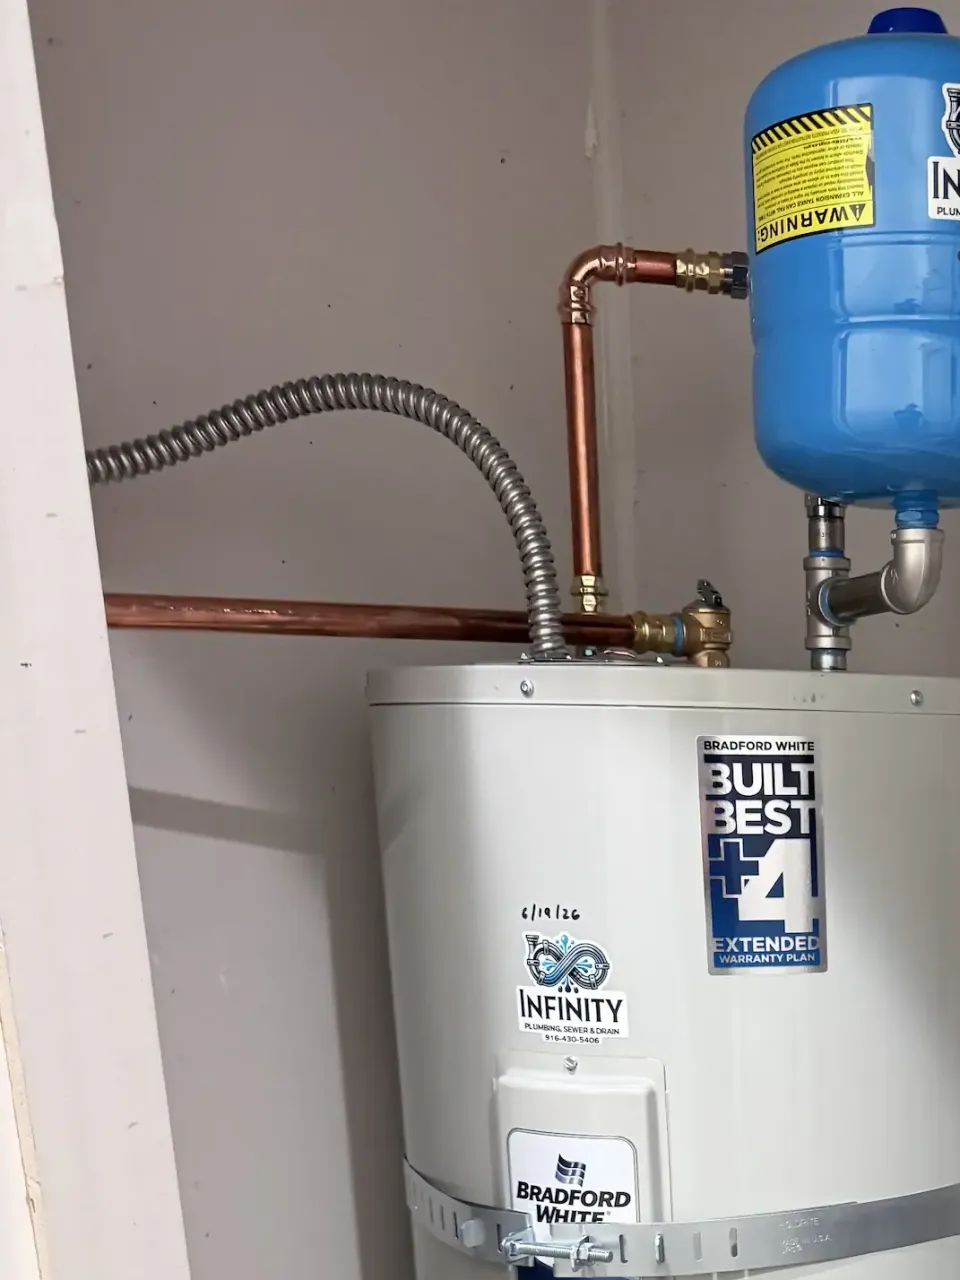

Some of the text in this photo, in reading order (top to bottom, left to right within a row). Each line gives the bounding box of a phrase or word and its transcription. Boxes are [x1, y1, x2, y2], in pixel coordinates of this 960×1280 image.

[758, 208, 848, 244] WARNING:
[704, 741, 815, 751] BRADFORD WHITE
[708, 762, 815, 797] BUILT
[711, 799, 816, 836] BEST
[521, 903, 581, 921] 6/19/26
[712, 936, 820, 953] EXTENDED
[719, 952, 815, 965] WARRANTY PLAN
[519, 988, 624, 1023] INFINITY
[524, 1022, 562, 1034] PLUMBING,
[563, 1026, 588, 1034] SEWER
[595, 1027, 620, 1035] DRAIN
[545, 1034, 600, 1044] 916-430-5406
[516, 1180, 632, 1209] BRADFORD
